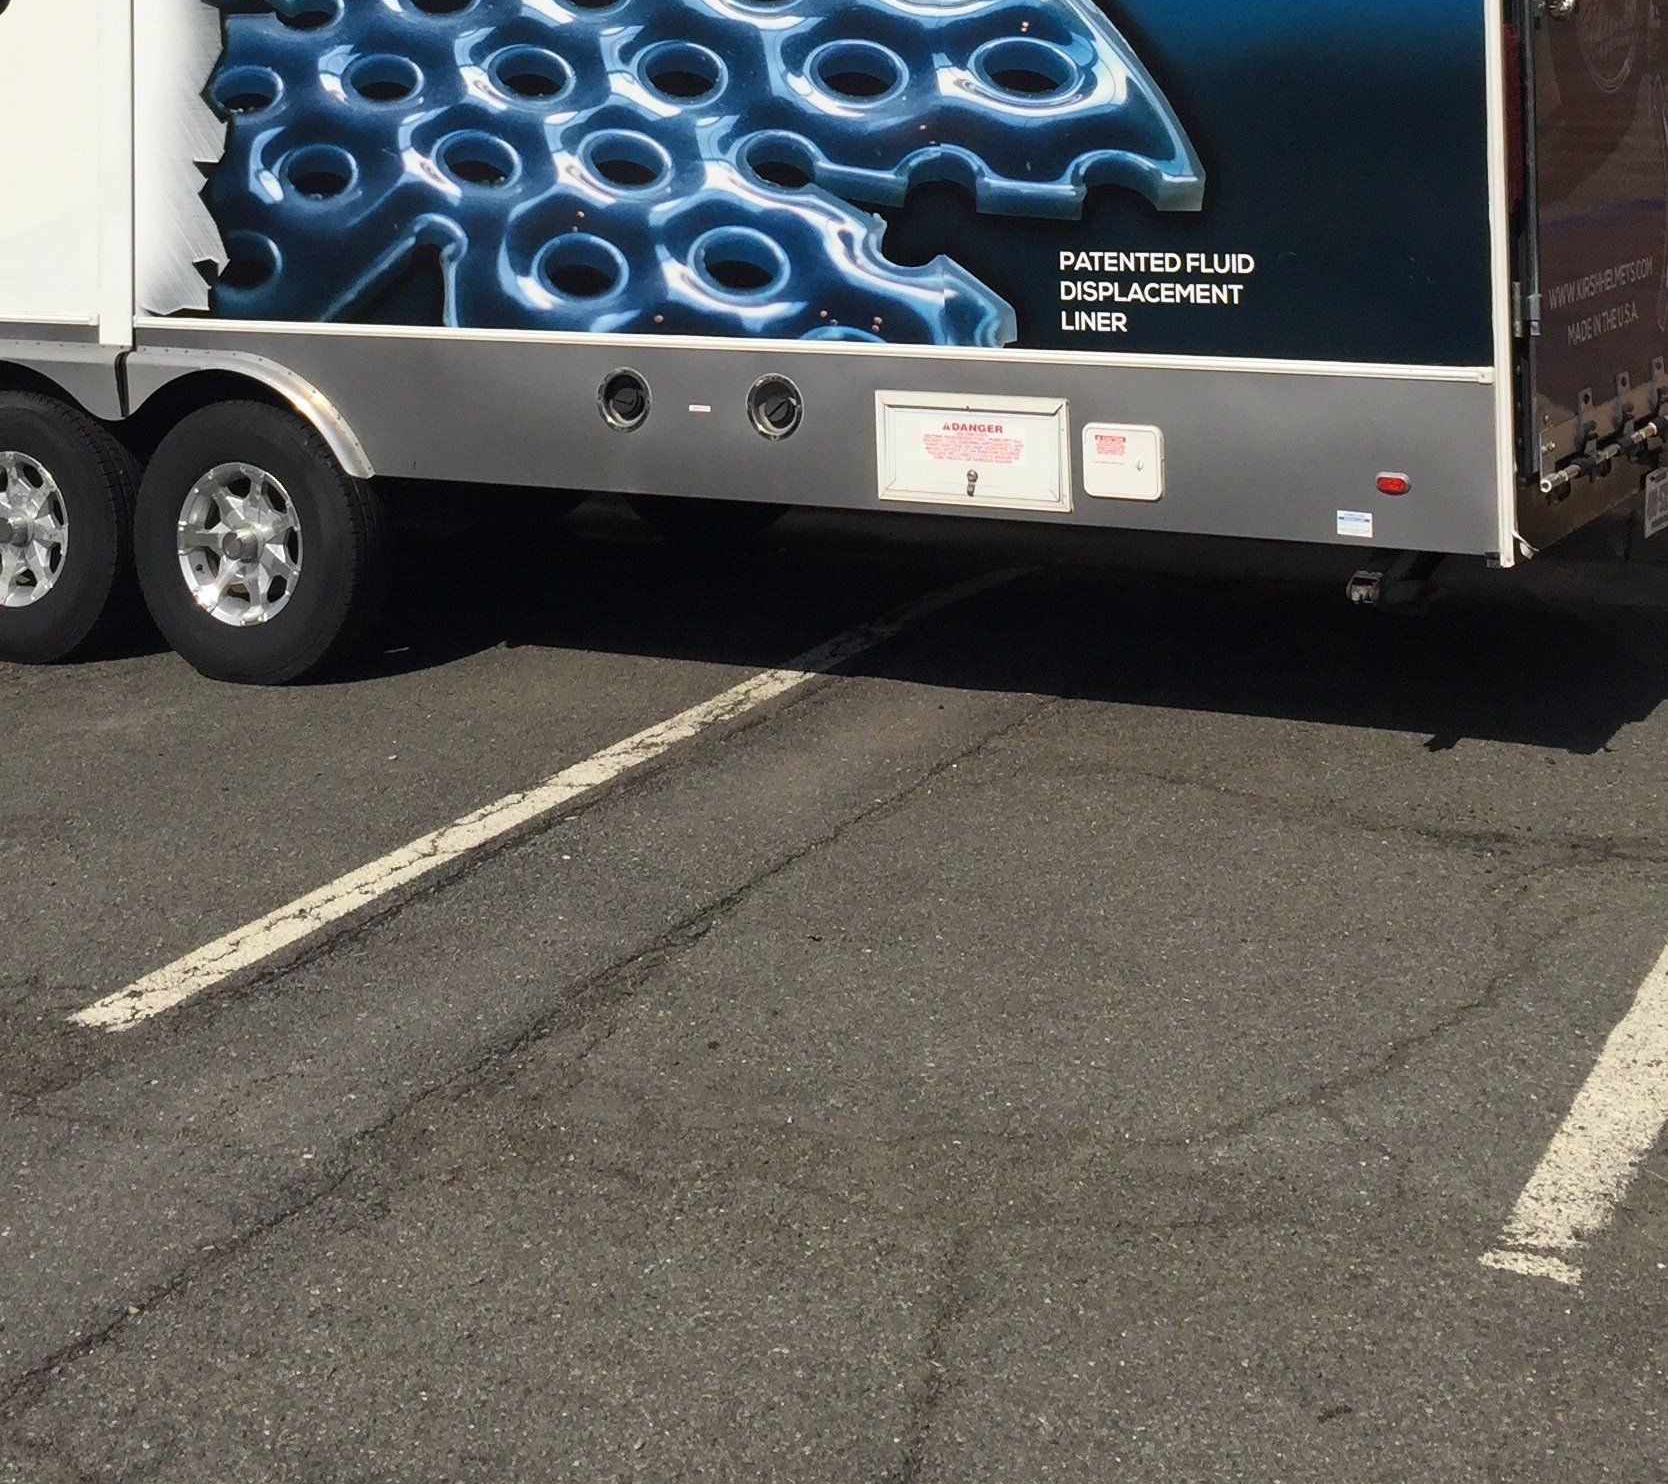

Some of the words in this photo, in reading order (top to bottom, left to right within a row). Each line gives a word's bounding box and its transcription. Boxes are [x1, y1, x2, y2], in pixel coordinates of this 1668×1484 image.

[1059, 251, 1182, 273] PATENTED
[1186, 253, 1255, 274] FLUID
[1060, 281, 1243, 304] DISPLACEMENT
[1061, 311, 1127, 332] LINER
[1567, 317, 1592, 346] MADE
[1601, 307, 1617, 333] THE
[952, 422, 1003, 433] DANGER
